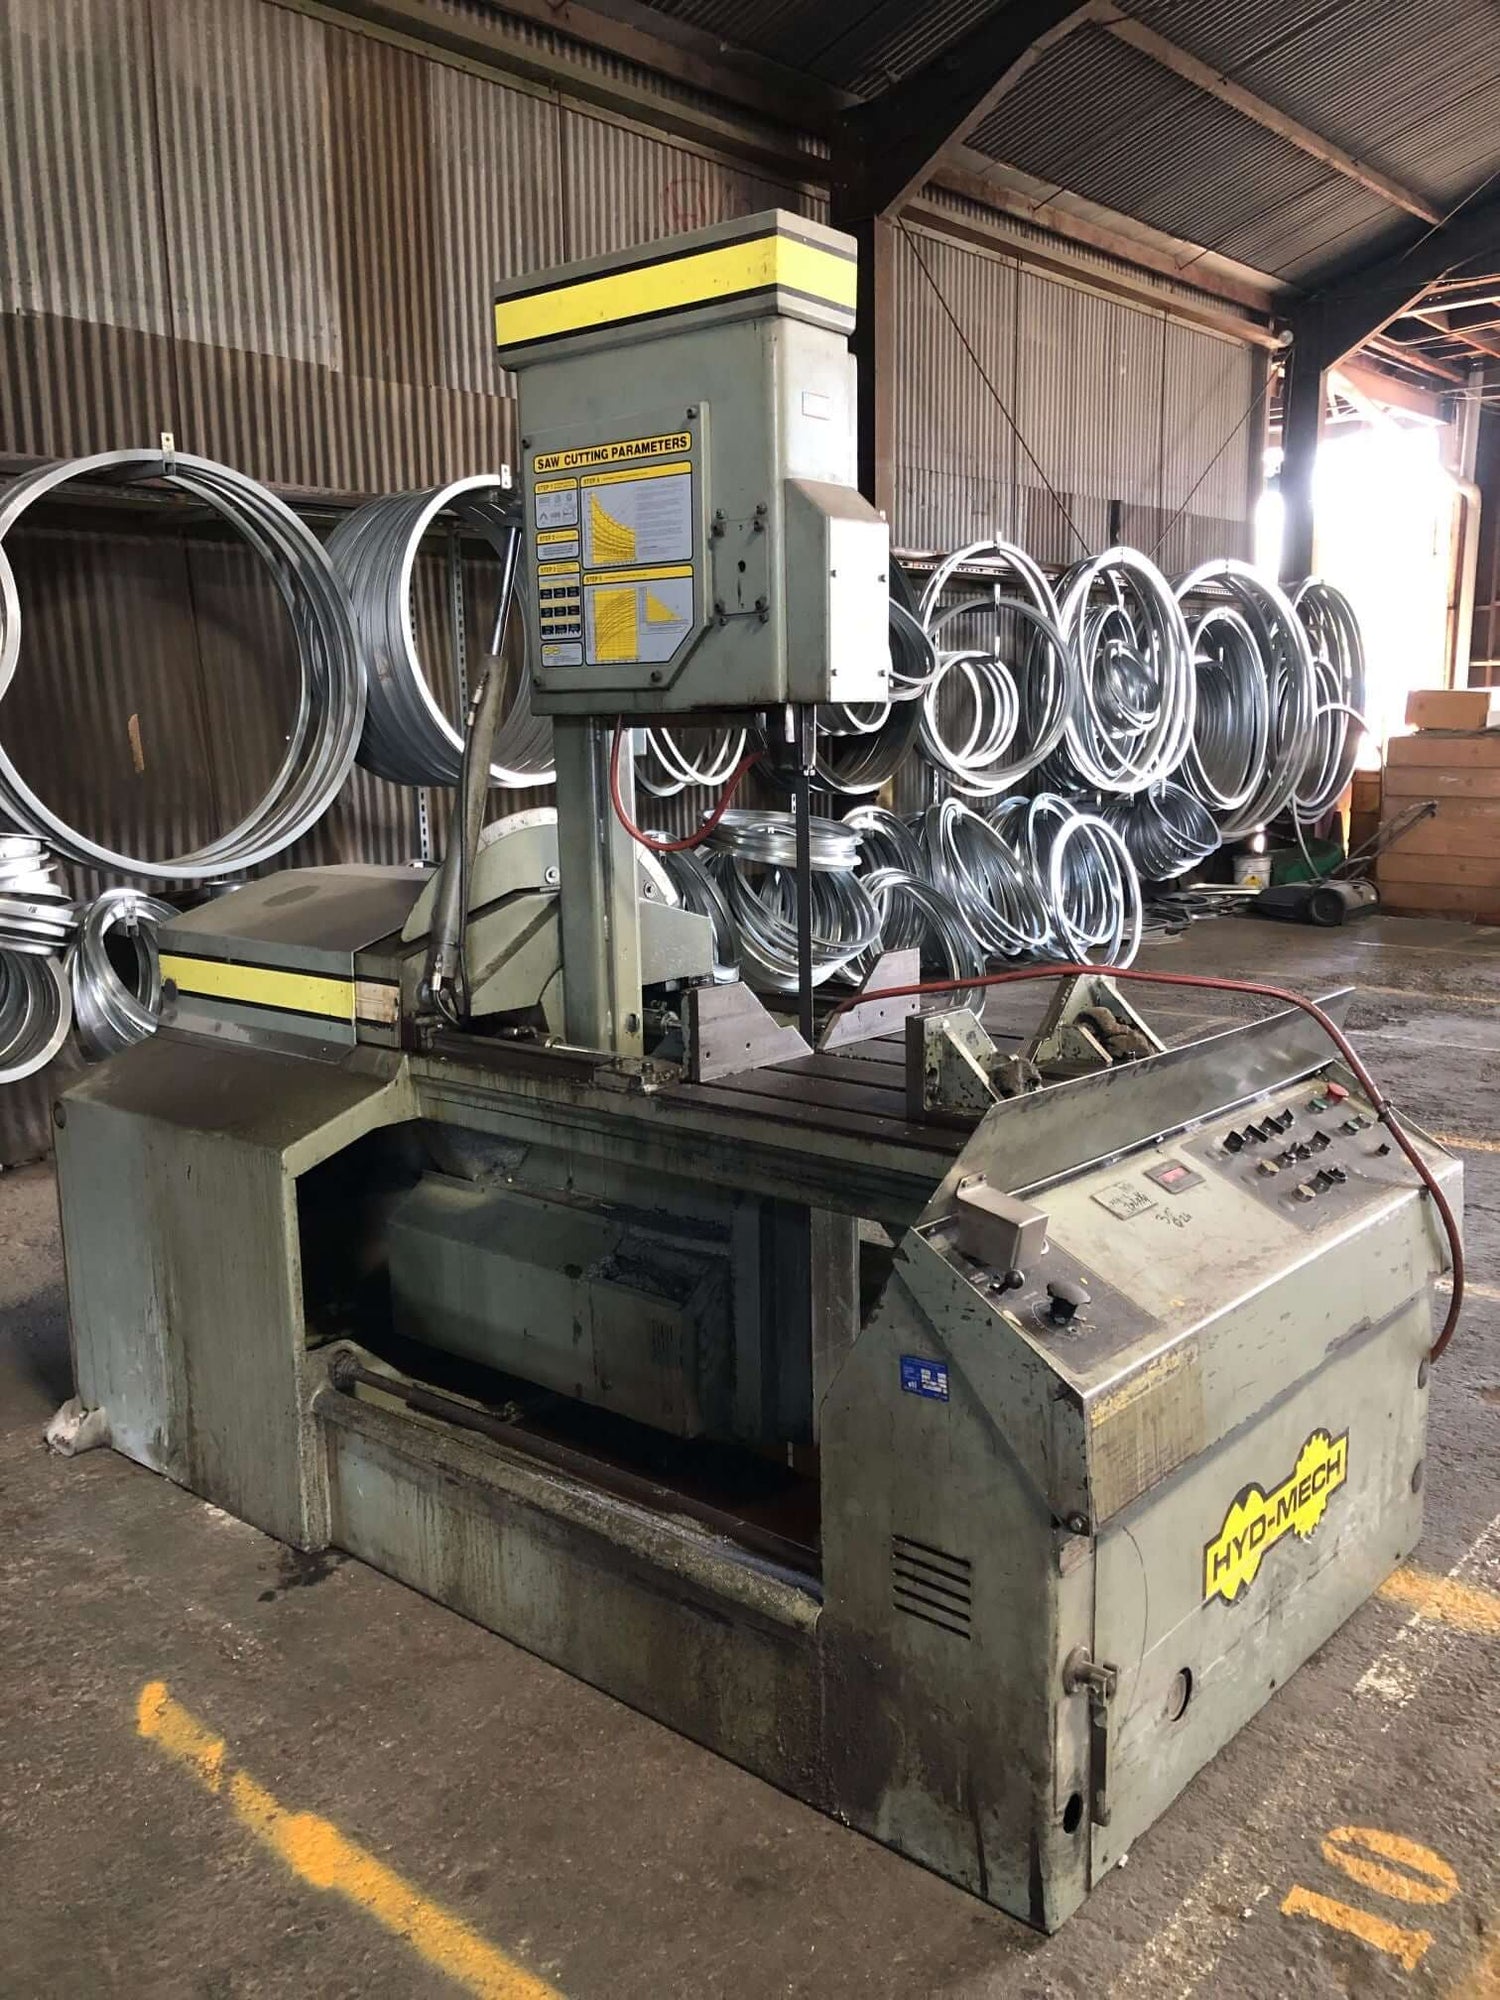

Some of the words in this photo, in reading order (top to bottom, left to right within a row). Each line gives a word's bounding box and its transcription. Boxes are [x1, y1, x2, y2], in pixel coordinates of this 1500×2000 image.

[537, 456, 560, 470] SAW
[564, 448, 609, 465] CUTTING
[611, 436, 688, 458] PARAMETERS
[1213, 1449, 1341, 1582] HYD-MECH
[1281, 1825, 1462, 1974] 10
